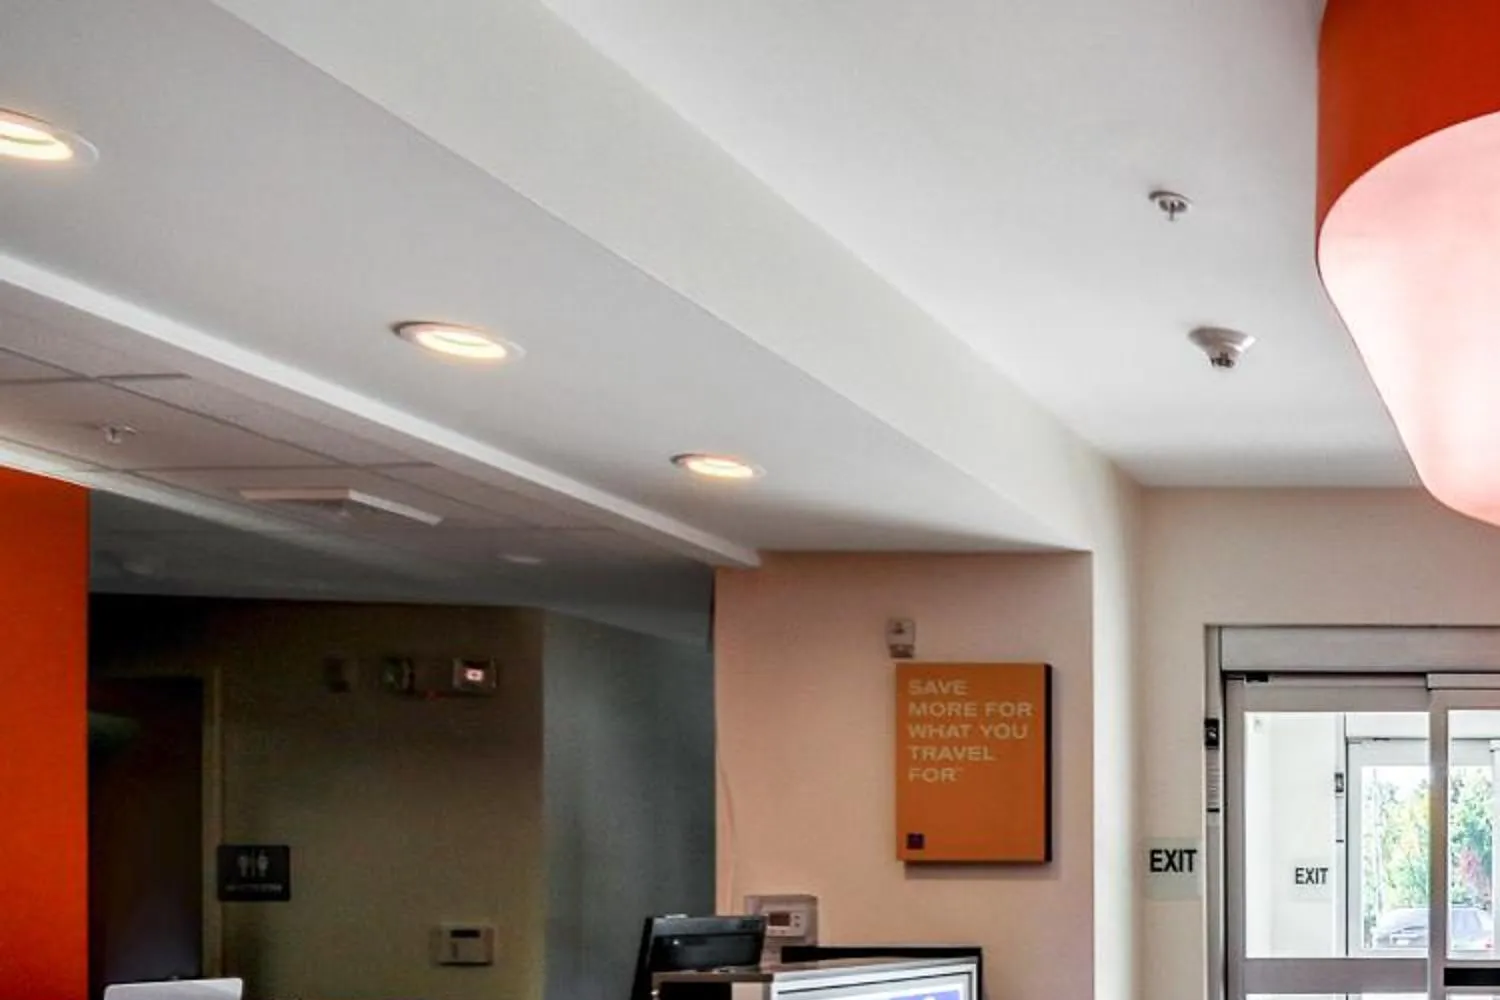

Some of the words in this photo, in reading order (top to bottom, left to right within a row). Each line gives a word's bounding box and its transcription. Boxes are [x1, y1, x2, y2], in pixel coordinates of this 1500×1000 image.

[908, 679, 968, 696] SAVE
[908, 702, 977, 718] MORE
[985, 701, 1033, 717] FOR
[907, 724, 972, 739] WHAT
[980, 722, 1027, 739] YOU
[907, 745, 995, 761] TRAVEL
[908, 768, 958, 783] FOR
[1150, 849, 1197, 873] EXIT
[1295, 867, 1328, 885] EXIT
